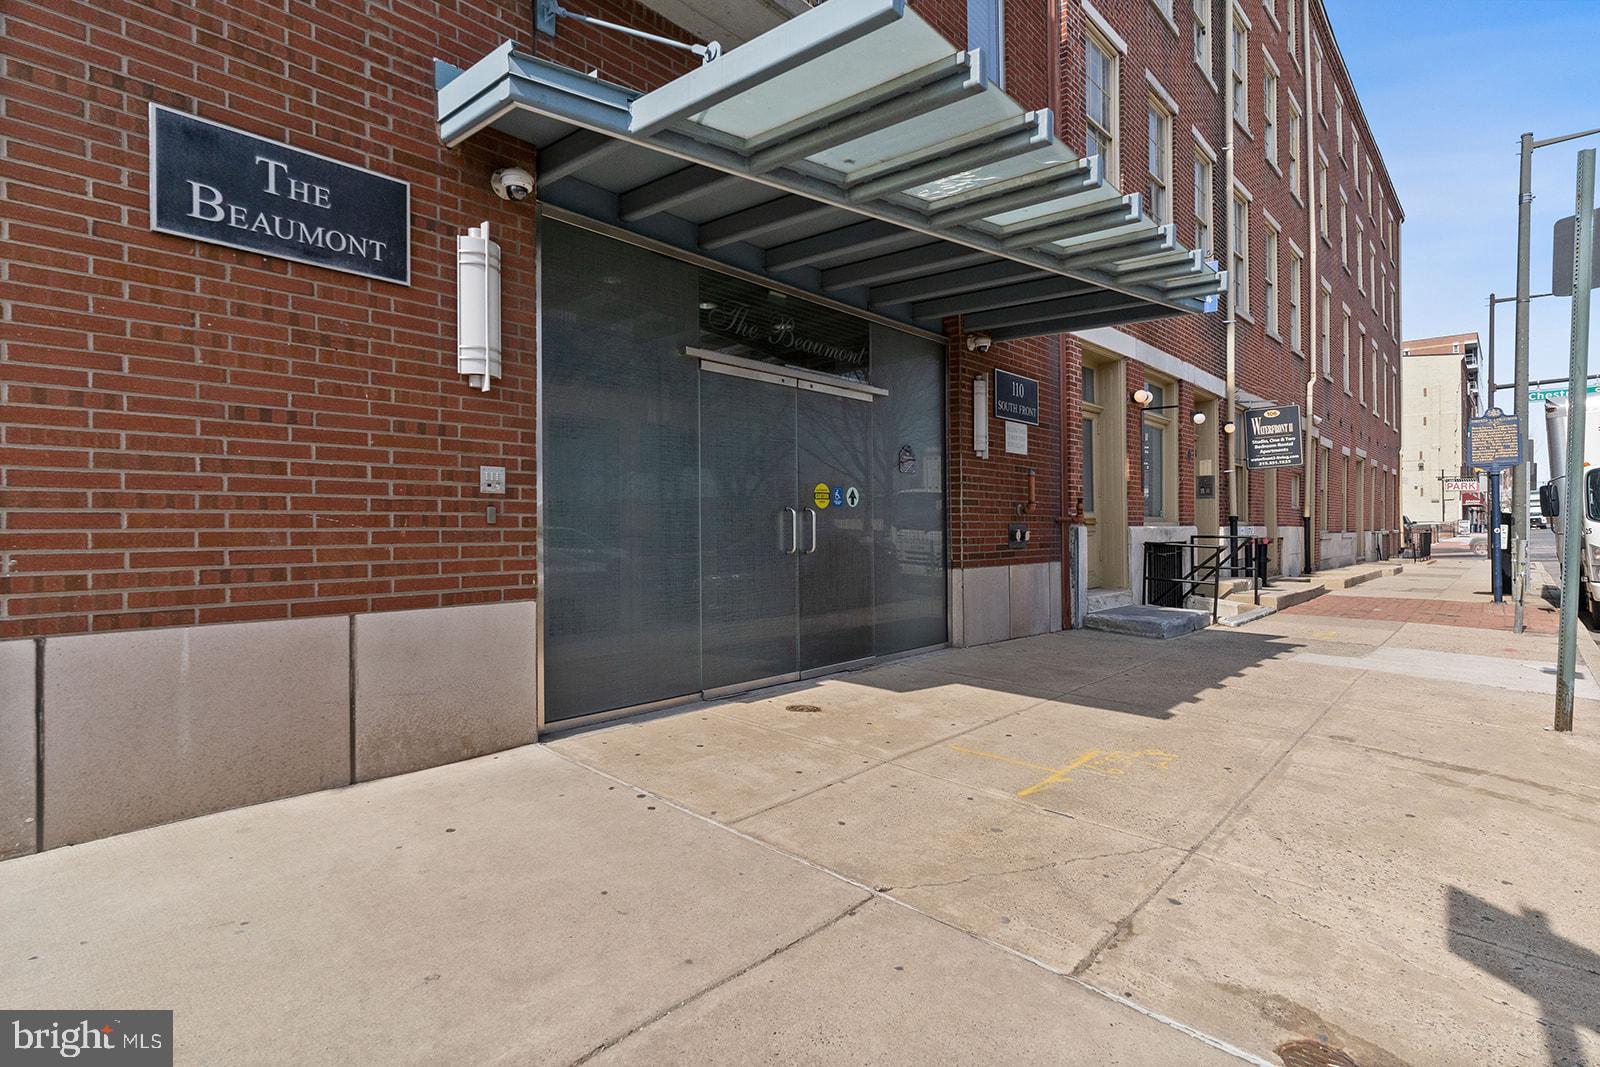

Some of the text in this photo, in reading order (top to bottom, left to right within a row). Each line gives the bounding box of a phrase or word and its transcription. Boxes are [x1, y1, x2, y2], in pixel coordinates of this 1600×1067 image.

[255, 156, 331, 209] THE
[185, 180, 387, 261] BEAUMONT
[709, 301, 866, 366] The Beaumont
[1012, 381, 1025, 398] 110
[1528, 390, 1569, 400] Chest
[998, 400, 1037, 417] SOUTH FRONT
[1251, 417, 1288, 435] WATERFRONT
[1447, 482, 1476, 490] PARK
